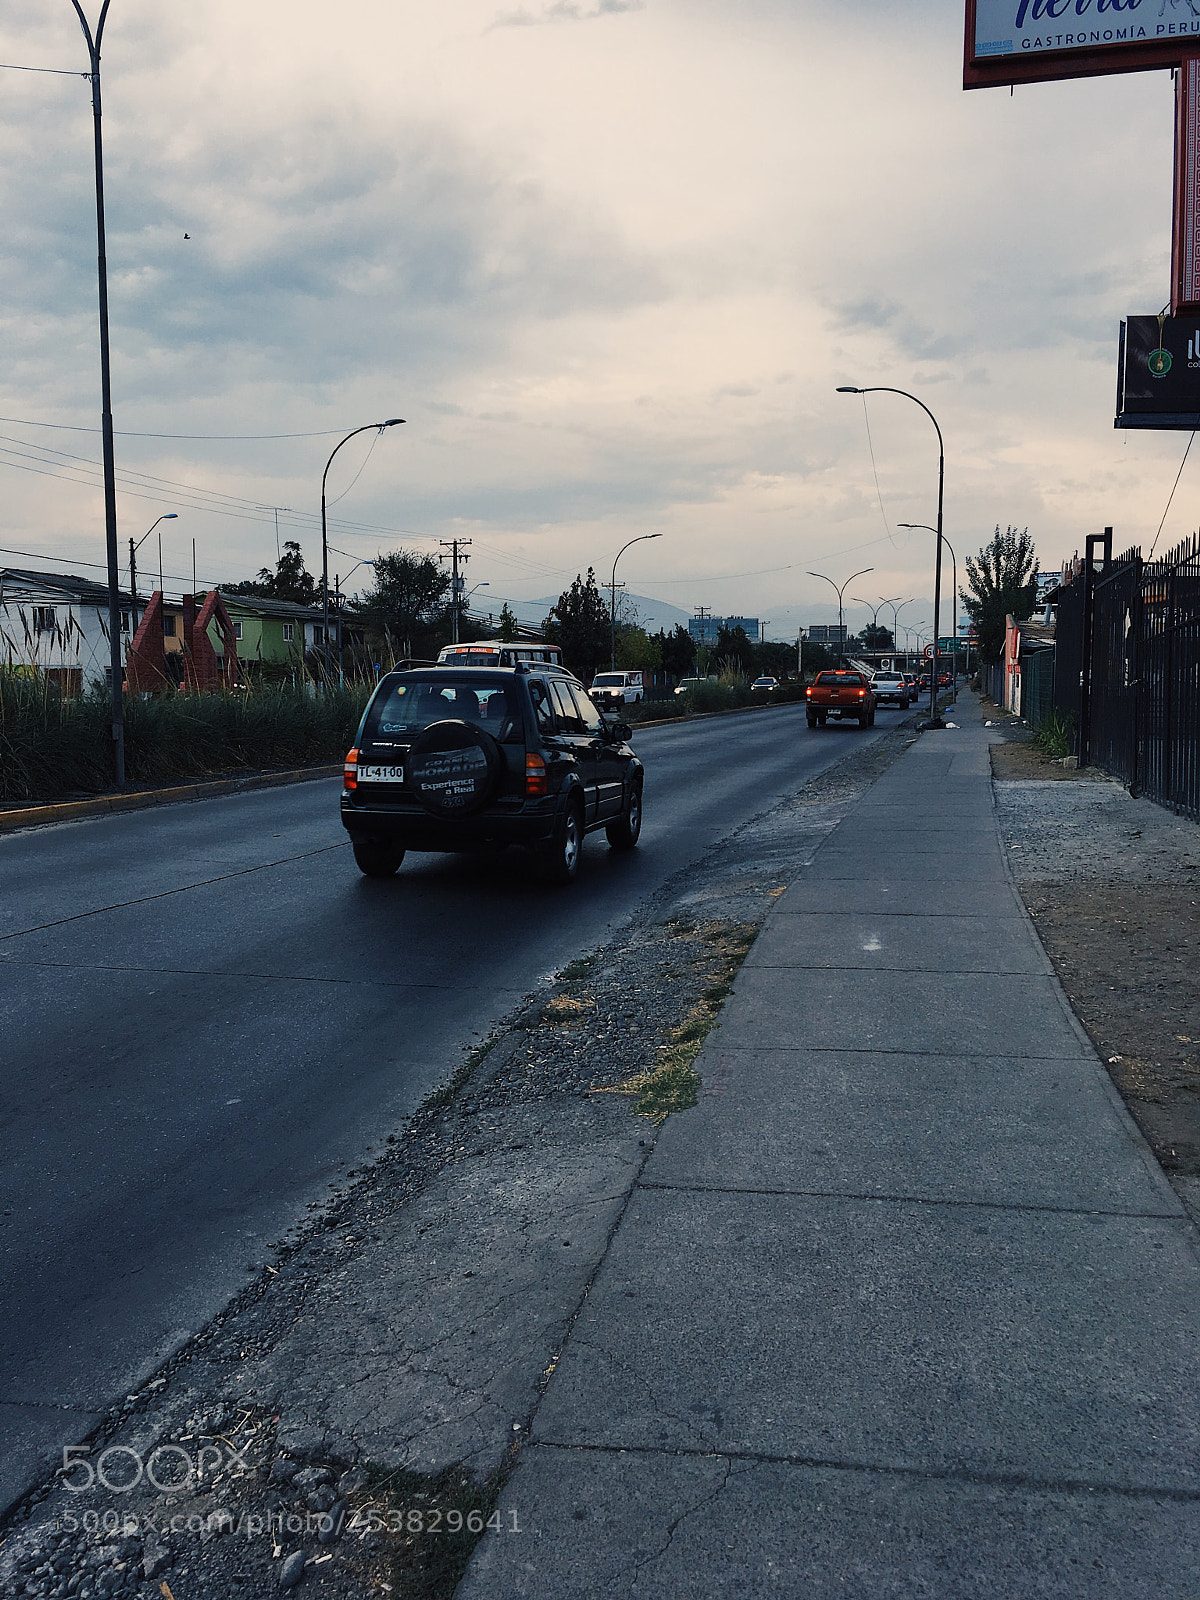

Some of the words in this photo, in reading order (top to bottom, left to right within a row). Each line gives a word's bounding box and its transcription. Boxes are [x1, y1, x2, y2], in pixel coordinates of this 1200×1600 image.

[1021, 26, 1147, 49] GASTRONOMÍA
[420, 778, 475, 791] Experience
[453, 785, 475, 794] Real
